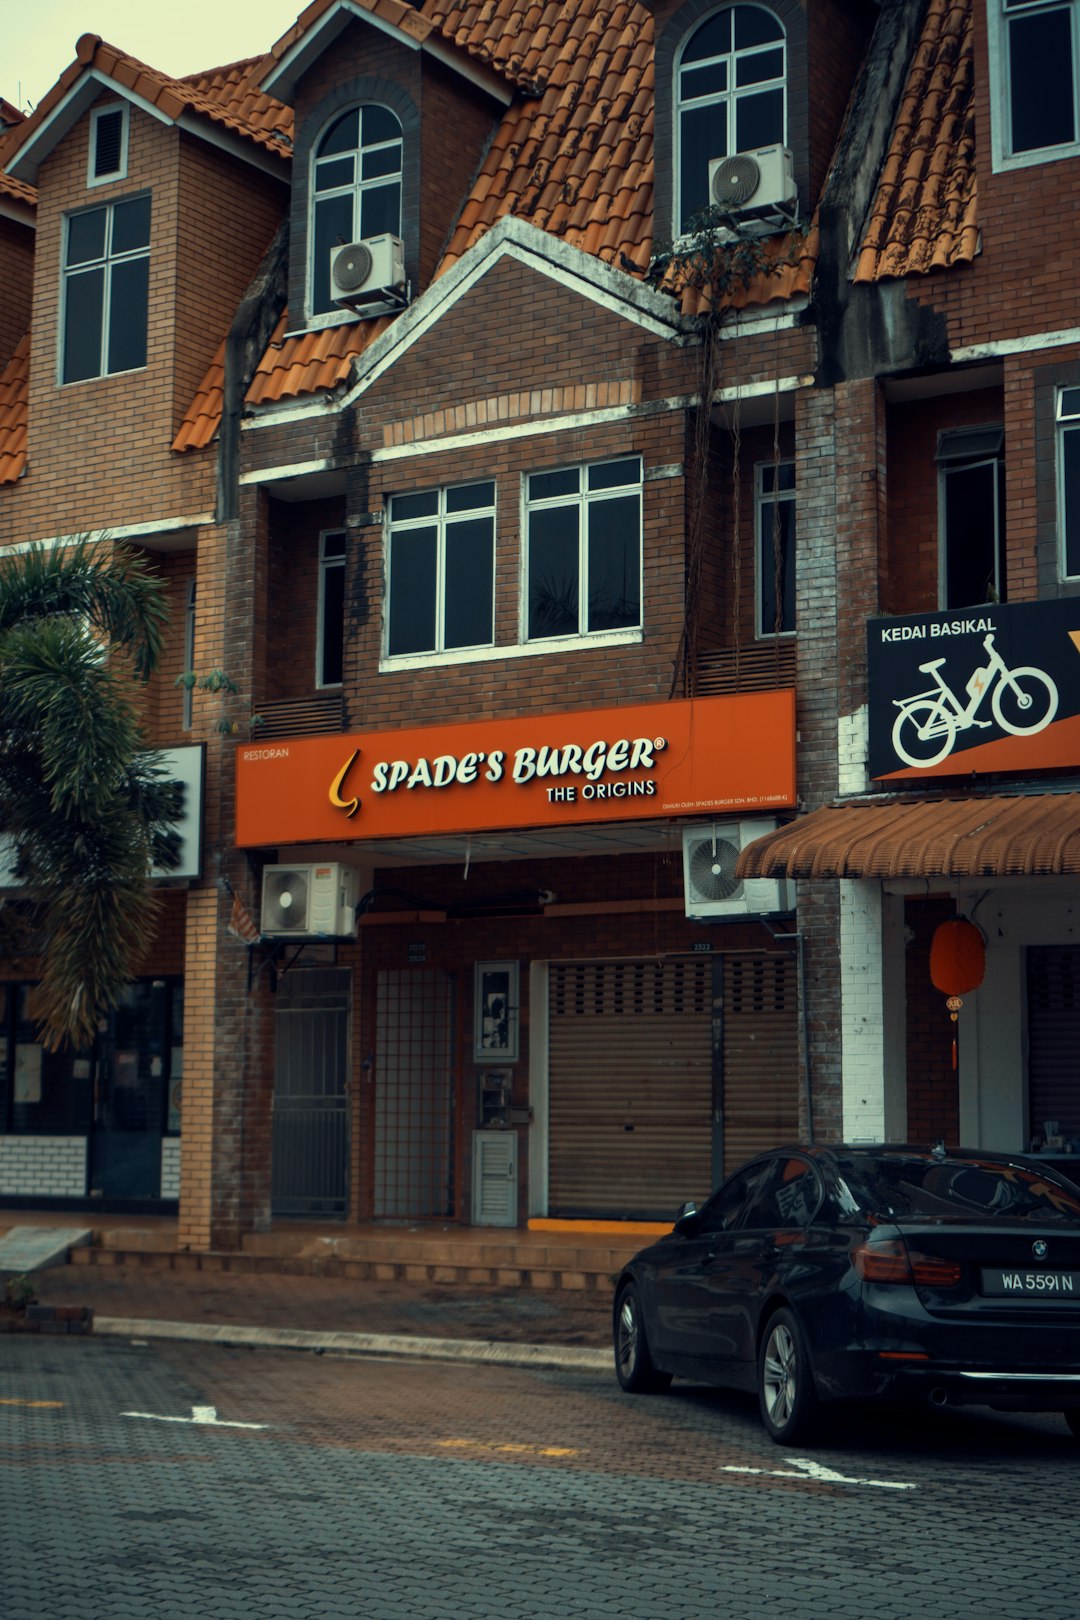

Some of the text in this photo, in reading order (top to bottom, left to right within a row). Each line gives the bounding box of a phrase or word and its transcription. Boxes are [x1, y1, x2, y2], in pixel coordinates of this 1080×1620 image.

[881, 617, 997, 643] KEDAI BASIKAL
[243, 747, 289, 761] RESTORAN
[546, 779, 655, 803] THE ORIGINS
[695, 799, 714, 807] SPADES
[714, 797, 734, 805] BURGER
